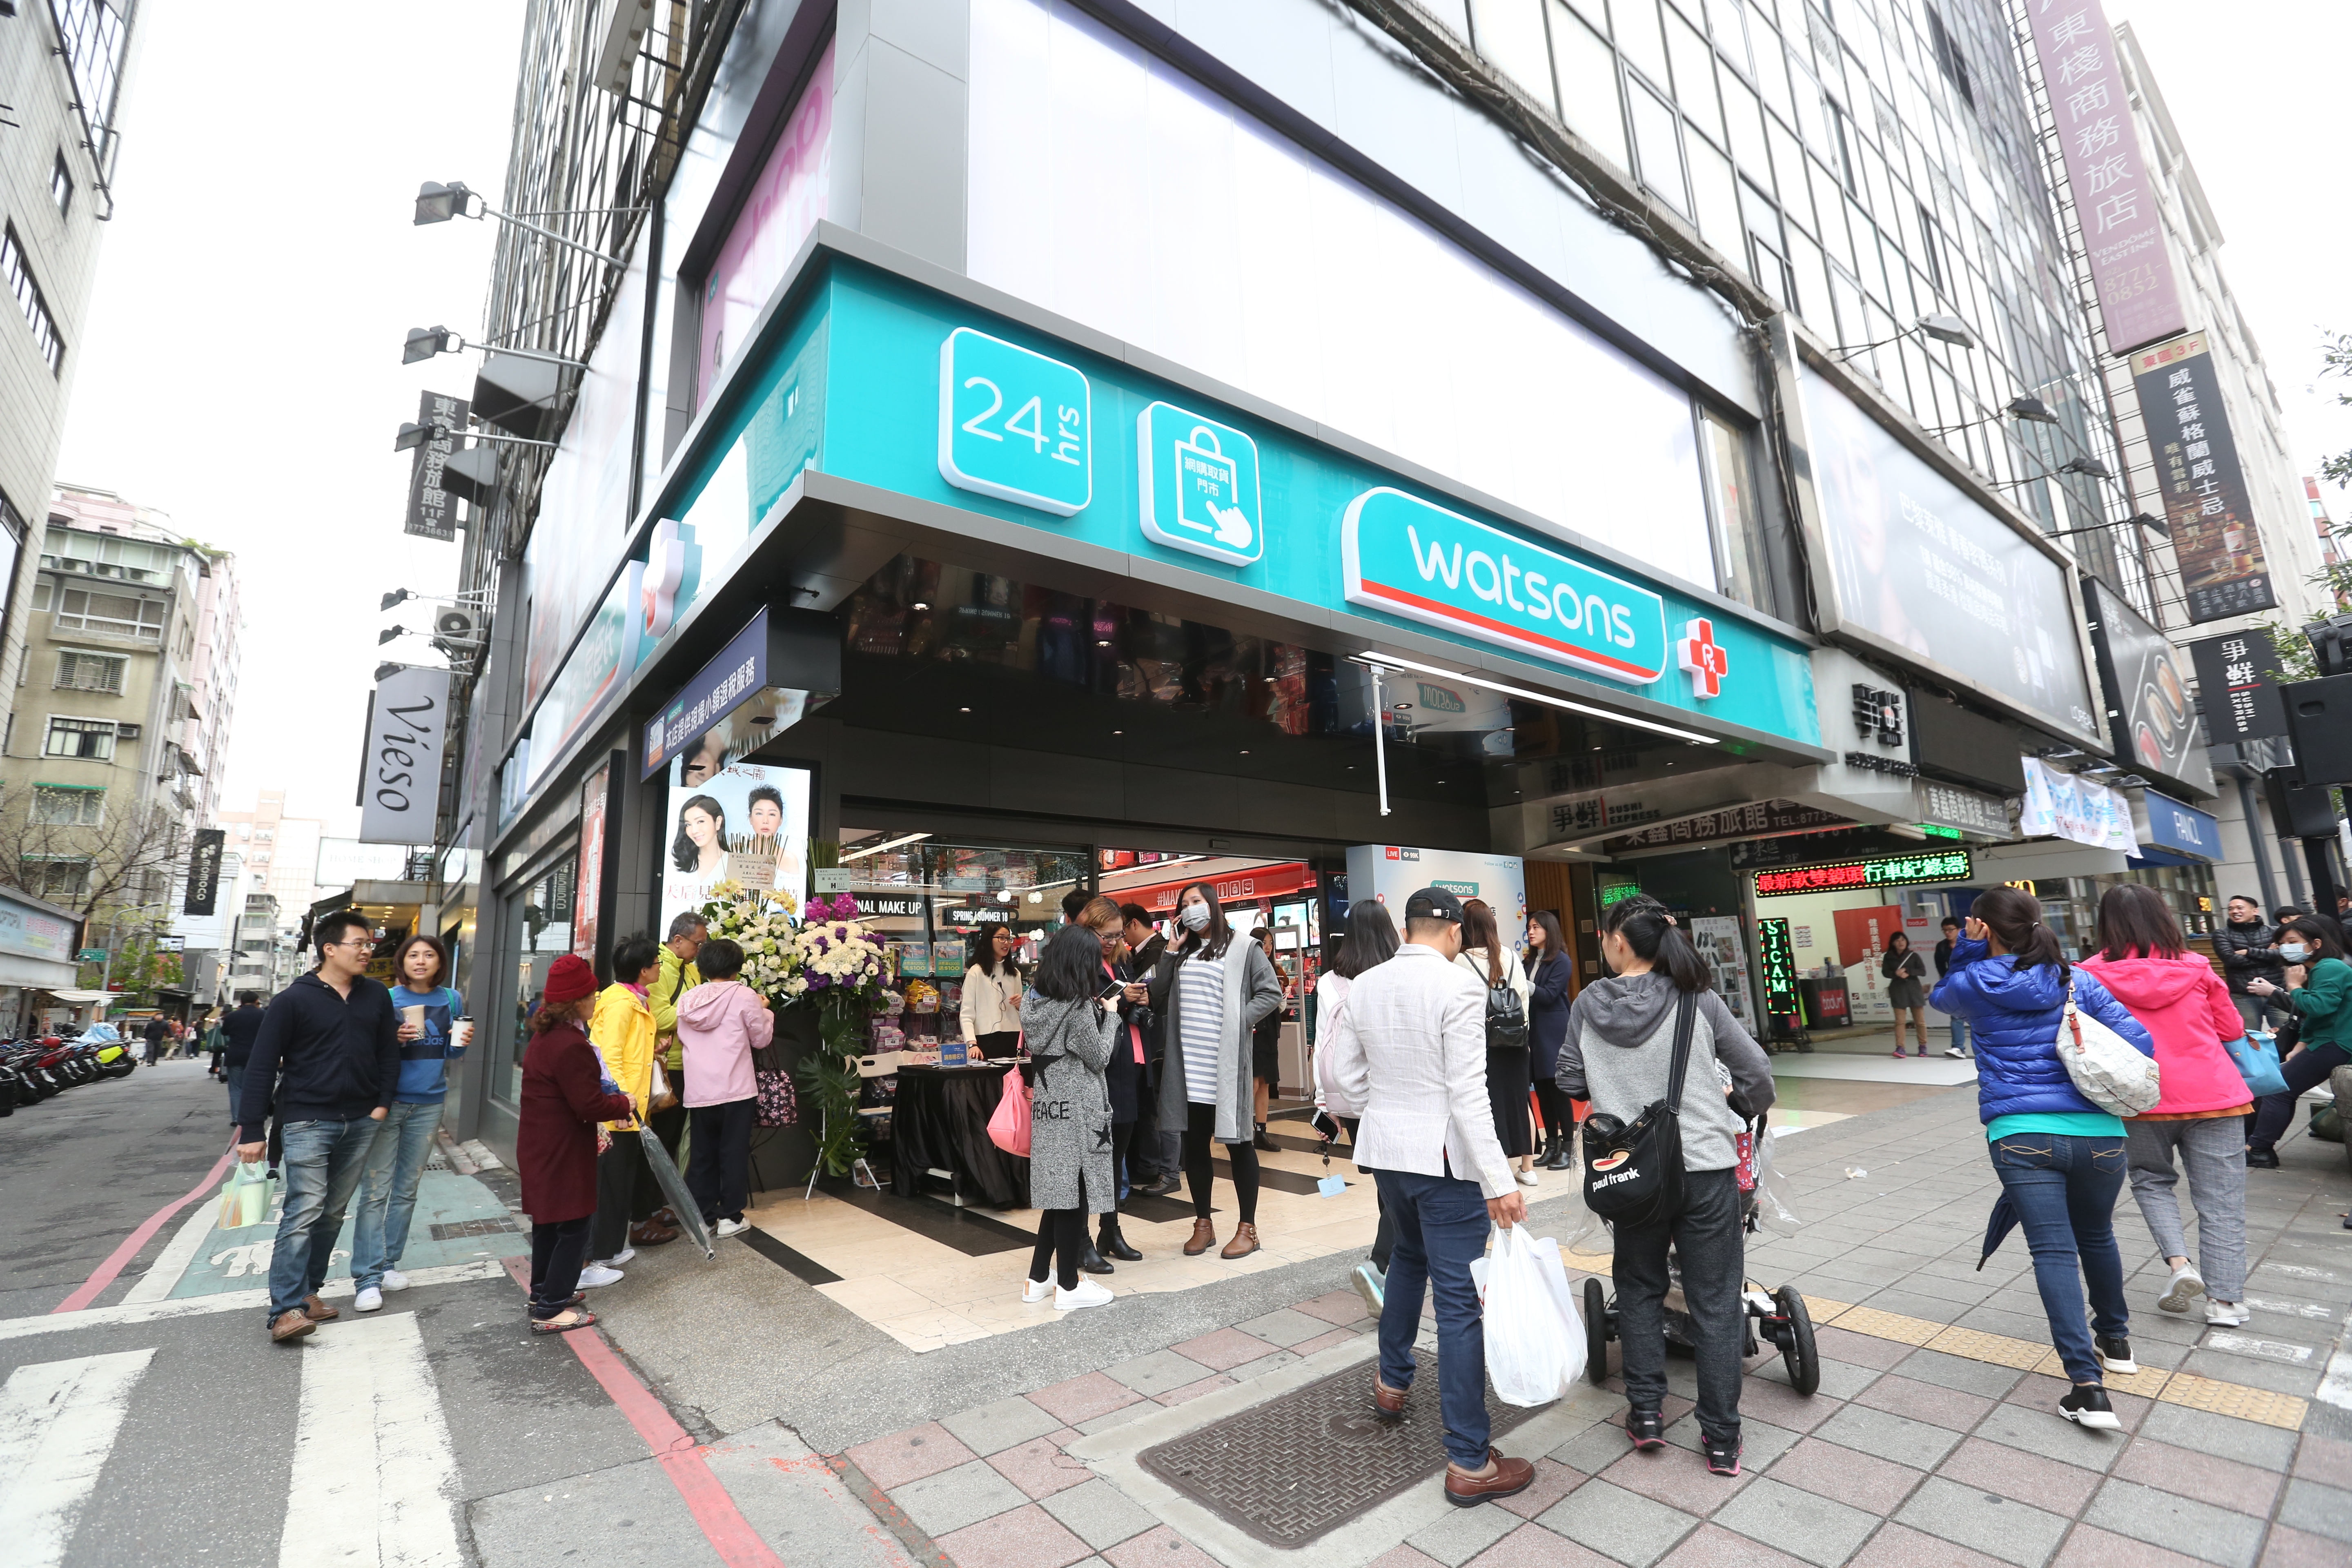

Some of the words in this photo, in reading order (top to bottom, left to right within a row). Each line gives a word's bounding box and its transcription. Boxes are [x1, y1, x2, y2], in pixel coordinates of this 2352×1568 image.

[2048, 7, 2138, 234] 東棧商務旅店
[2092, 227, 2156, 258] VENDÔME
[2101, 248, 2129, 266] EAST
[2130, 238, 2155, 254] INN
[2104, 263, 2163, 292] 8771-
[2107, 276, 2159, 305] 0852
[962, 376, 1050, 454] 24
[1051, 404, 1080, 466] hrs
[2169, 368, 2225, 516] 威雀蘇格蘭威士忌
[1184, 456, 1230, 485] 網購取貨
[1196, 477, 1219, 497] 門市
[420, 506, 445, 519] 11F
[1407, 524, 1635, 648] watsons
[2221, 639, 2256, 686] 爭鮮
[665, 656, 755, 751] 本店提供現場小額退稅服務
[2230, 693, 2249, 732] EXPRESS
[2240, 691, 2256, 718] SUSHI
[376, 695, 434, 812] Vieso
[1553, 800, 1600, 833] 爭鮮
[1609, 802, 1643, 815] SUSHI
[1610, 809, 1661, 825] EXPRESS
[2173, 811, 2203, 845] FANCL
[329, 854, 364, 864] HOME
[367, 856, 396, 864] SHOP
[1754, 839, 1780, 857] 東區
[196, 859, 211, 900] momoco
[1758, 855, 1966, 892] 最新款雙鏡頭行車紀錄器
[855, 900, 875, 913] NAL
[879, 901, 906, 914] MAKE
[909, 902, 922, 915] UP
[953, 911, 973, 921] SPRING
[978, 911, 1000, 922] SUMMER
[1002, 912, 1008, 922] 18
[1767, 920, 1788, 992] SJCAM
[1032, 1101, 1069, 1120] PEACE
[1592, 1175, 1608, 1192] paul
[1608, 1167, 1641, 1185] frank
